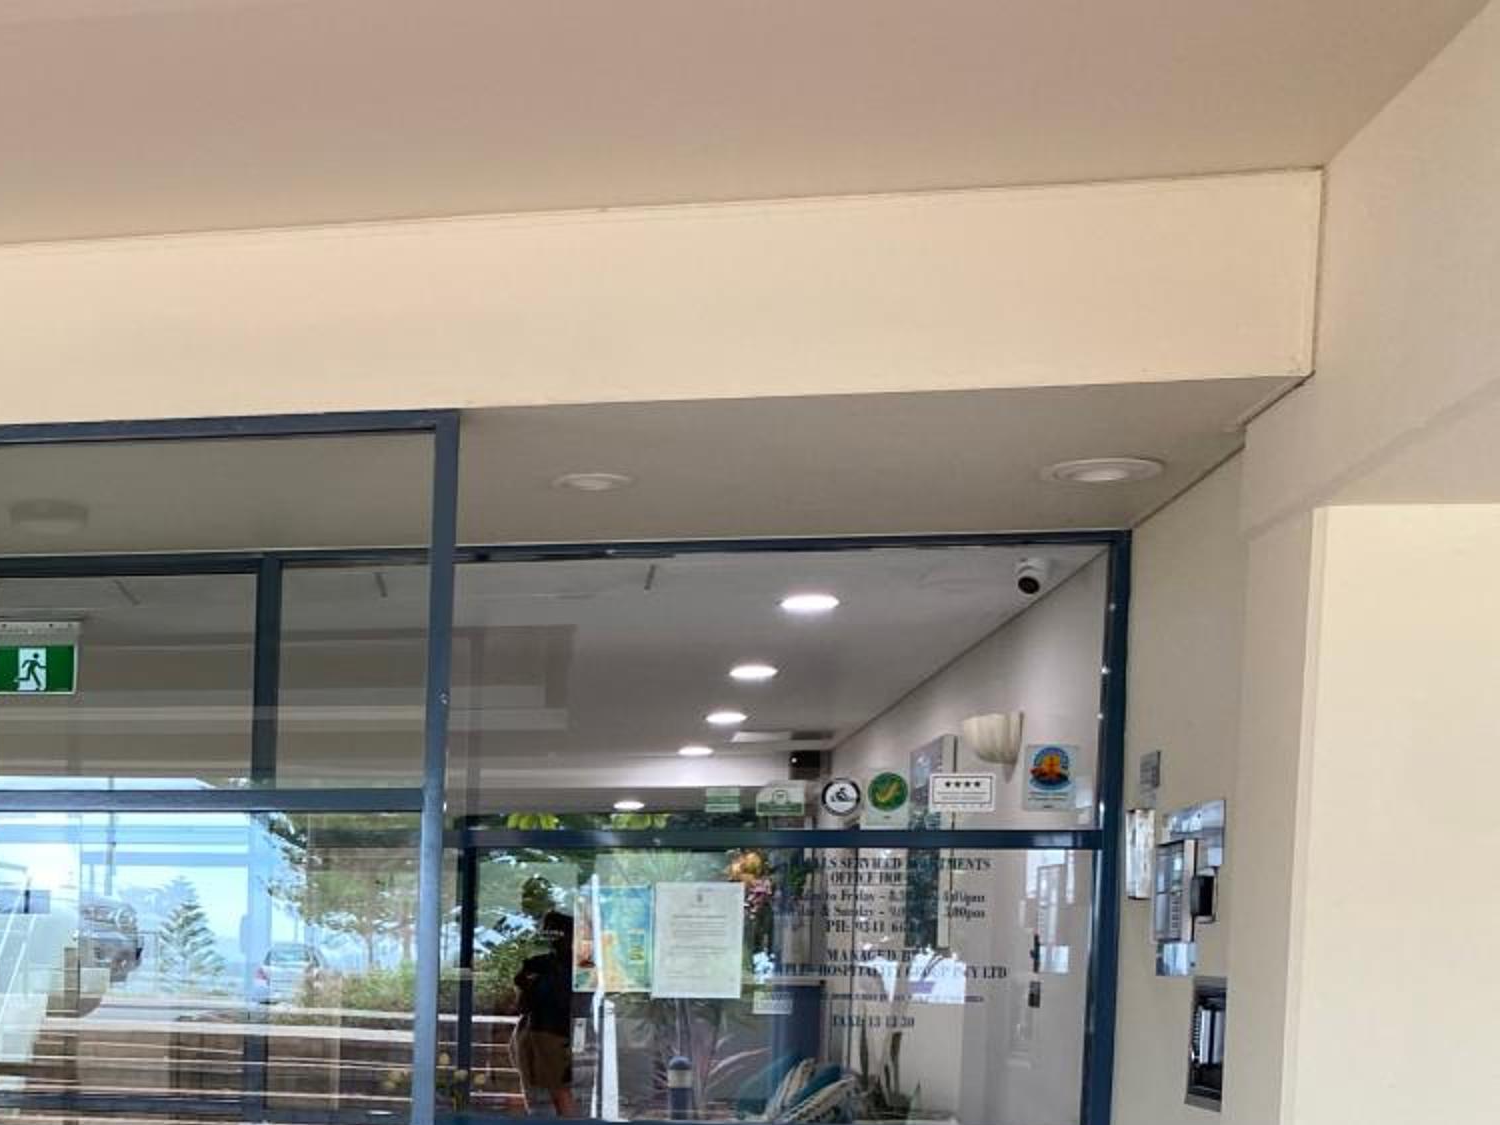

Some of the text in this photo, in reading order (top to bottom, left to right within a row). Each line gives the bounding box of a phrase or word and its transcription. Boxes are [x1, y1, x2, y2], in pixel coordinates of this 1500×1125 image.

[830, 870, 874, 885] OFFICE
[827, 948, 897, 963] MANAGED
[982, 965, 1008, 979] LTD
